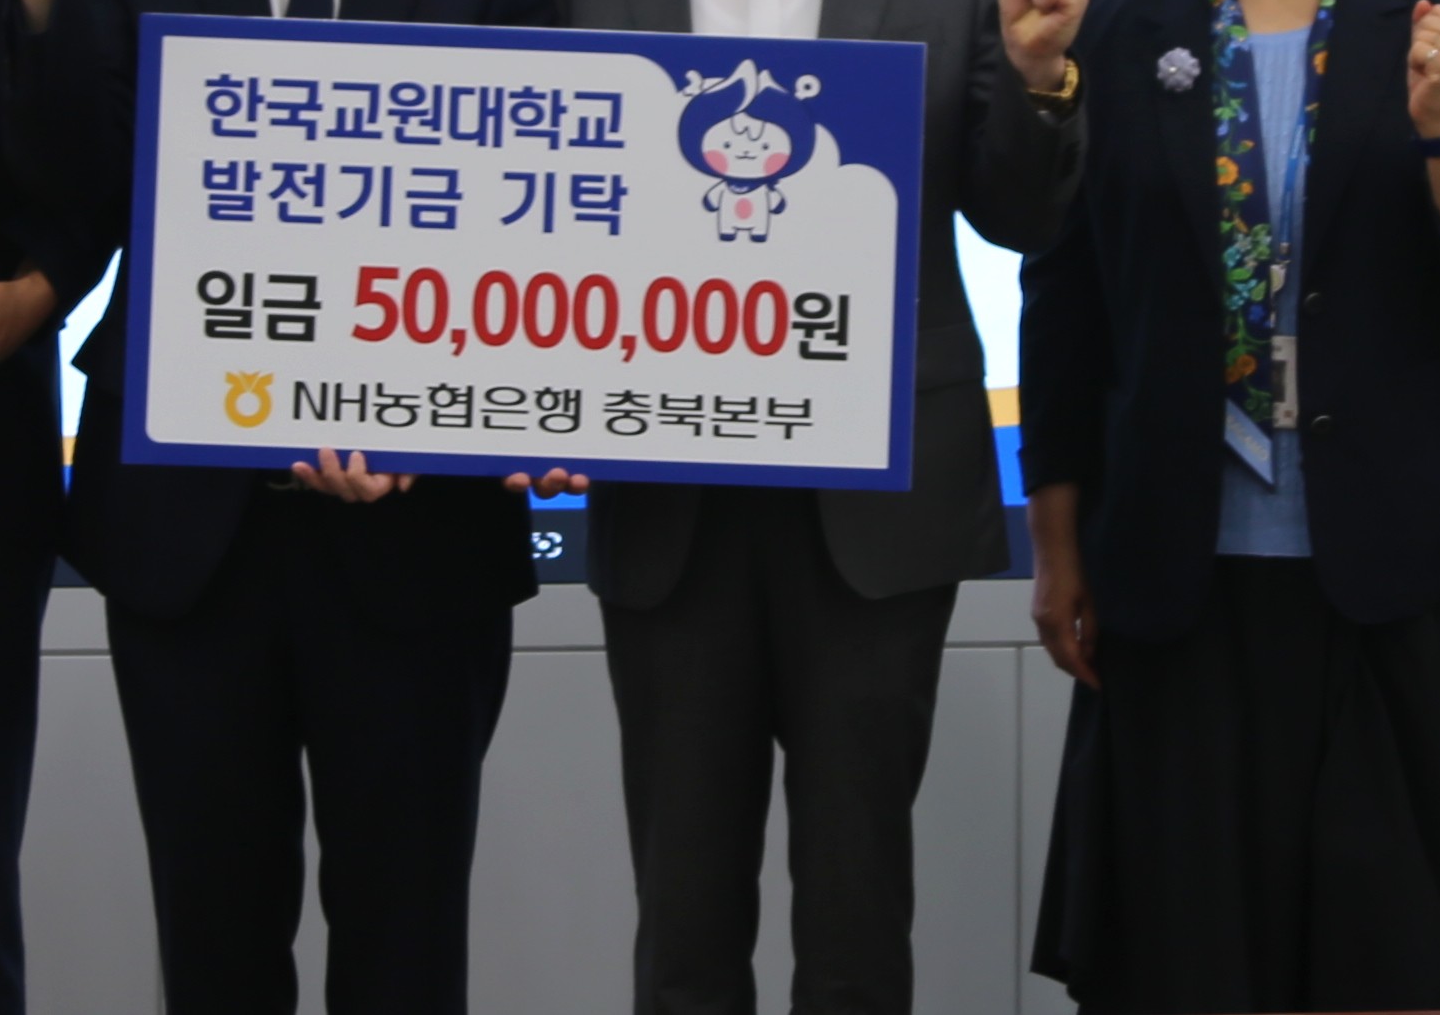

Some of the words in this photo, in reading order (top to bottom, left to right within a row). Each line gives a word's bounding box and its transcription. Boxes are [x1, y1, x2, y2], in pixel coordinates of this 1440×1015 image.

[205, 73, 625, 151] 한국교원대학교
[202, 159, 464, 230] 발전기금
[501, 171, 628, 236] 기탁
[197, 270, 322, 342] 일금
[351, 266, 850, 363] 50,000,000원
[293, 381, 583, 433] NH농협은행
[603, 389, 814, 440] 충북본부
